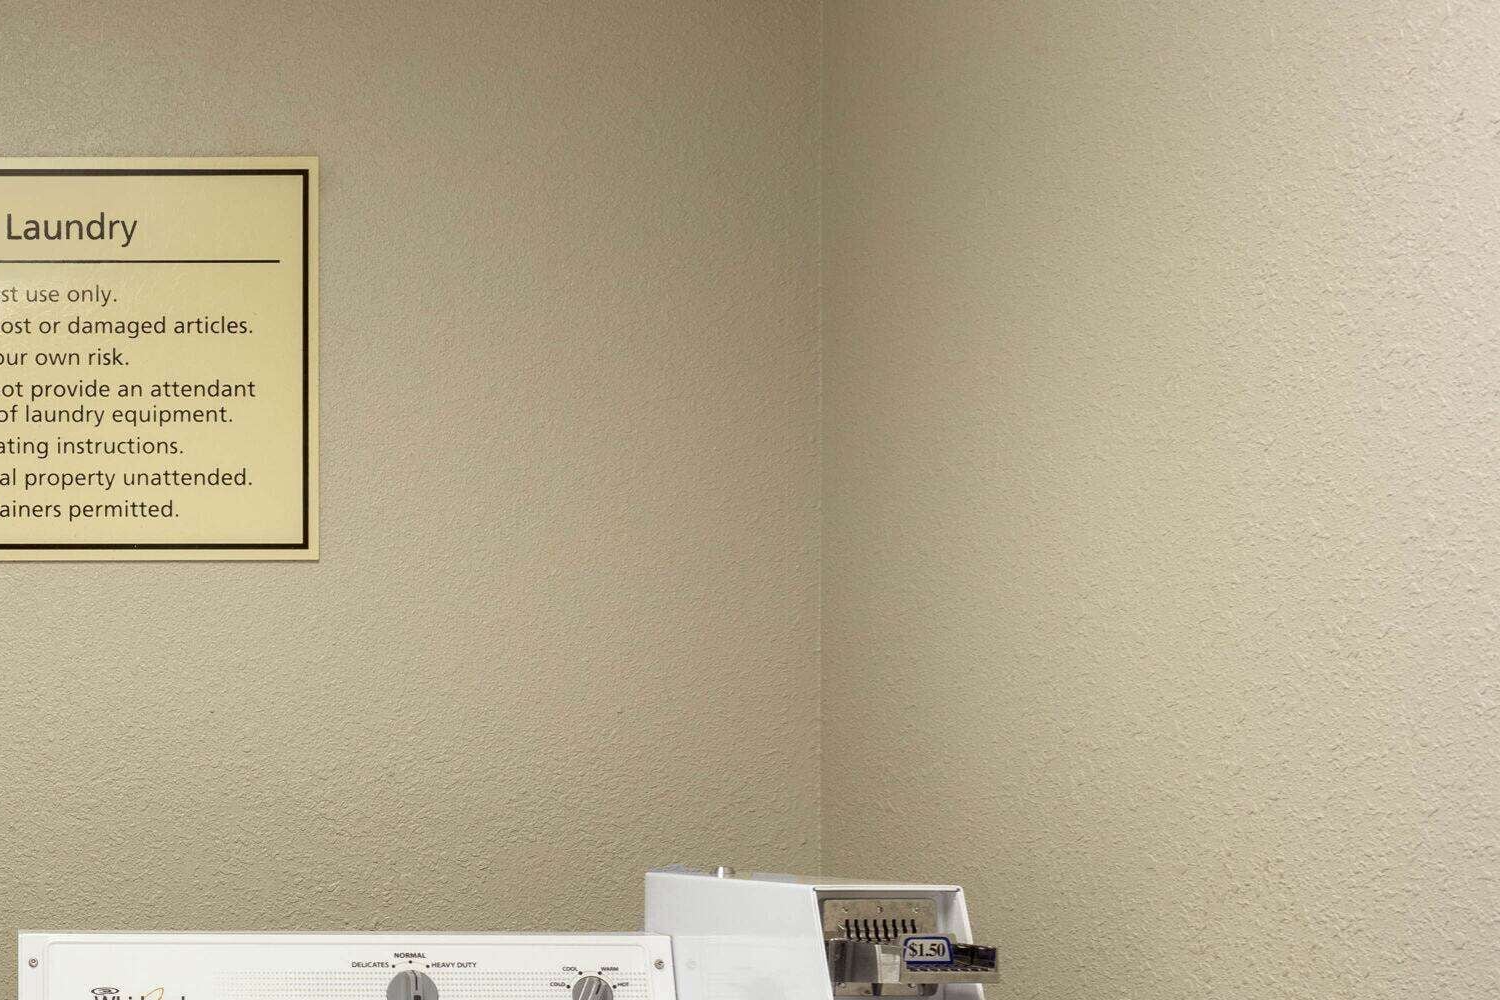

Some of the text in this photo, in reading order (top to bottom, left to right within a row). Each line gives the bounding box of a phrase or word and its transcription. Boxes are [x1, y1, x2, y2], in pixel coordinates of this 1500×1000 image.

[6, 211, 138, 249] Laundry
[26, 288, 60, 305] use
[66, 283, 118, 307] only.
[36, 319, 62, 337] or
[67, 315, 166, 339] damaged
[173, 315, 253, 337] articles.
[34, 351, 84, 366] own
[88, 345, 130, 368] risk.
[30, 378, 111, 402] provide
[116, 383, 144, 400] an
[148, 378, 256, 401] attendant
[25, 402, 106, 428] laundry
[108, 404, 233, 428] equipment.
[57, 434, 184, 457] instructions.
[24, 469, 116, 491] property
[123, 467, 253, 489] unattended.
[68, 499, 180, 523] permitted.
[908, 942, 946, 957] $1.50
[351, 961, 390, 969] DELICATES
[431, 961, 477, 969] HEAVY DUTY
